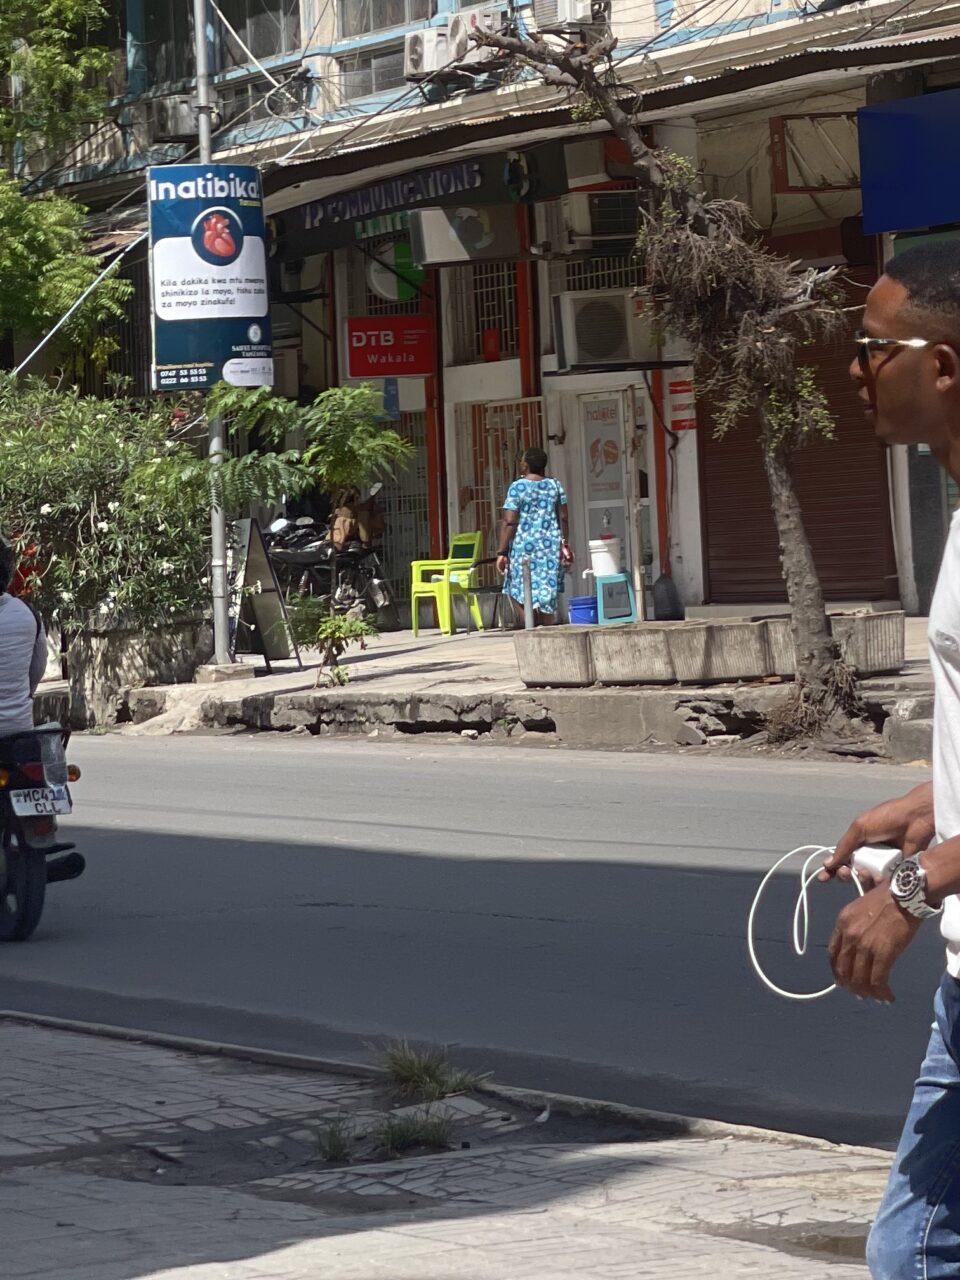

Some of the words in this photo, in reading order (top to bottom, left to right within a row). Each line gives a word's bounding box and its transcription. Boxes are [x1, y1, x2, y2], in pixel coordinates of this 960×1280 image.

[160, 279, 177, 287] Kila
[181, 277, 209, 286] dakika
[161, 288, 199, 297] shinikizo
[351, 330, 395, 347] DTB
[366, 352, 416, 364] Wakala
[34, 802, 61, 814] CLL
